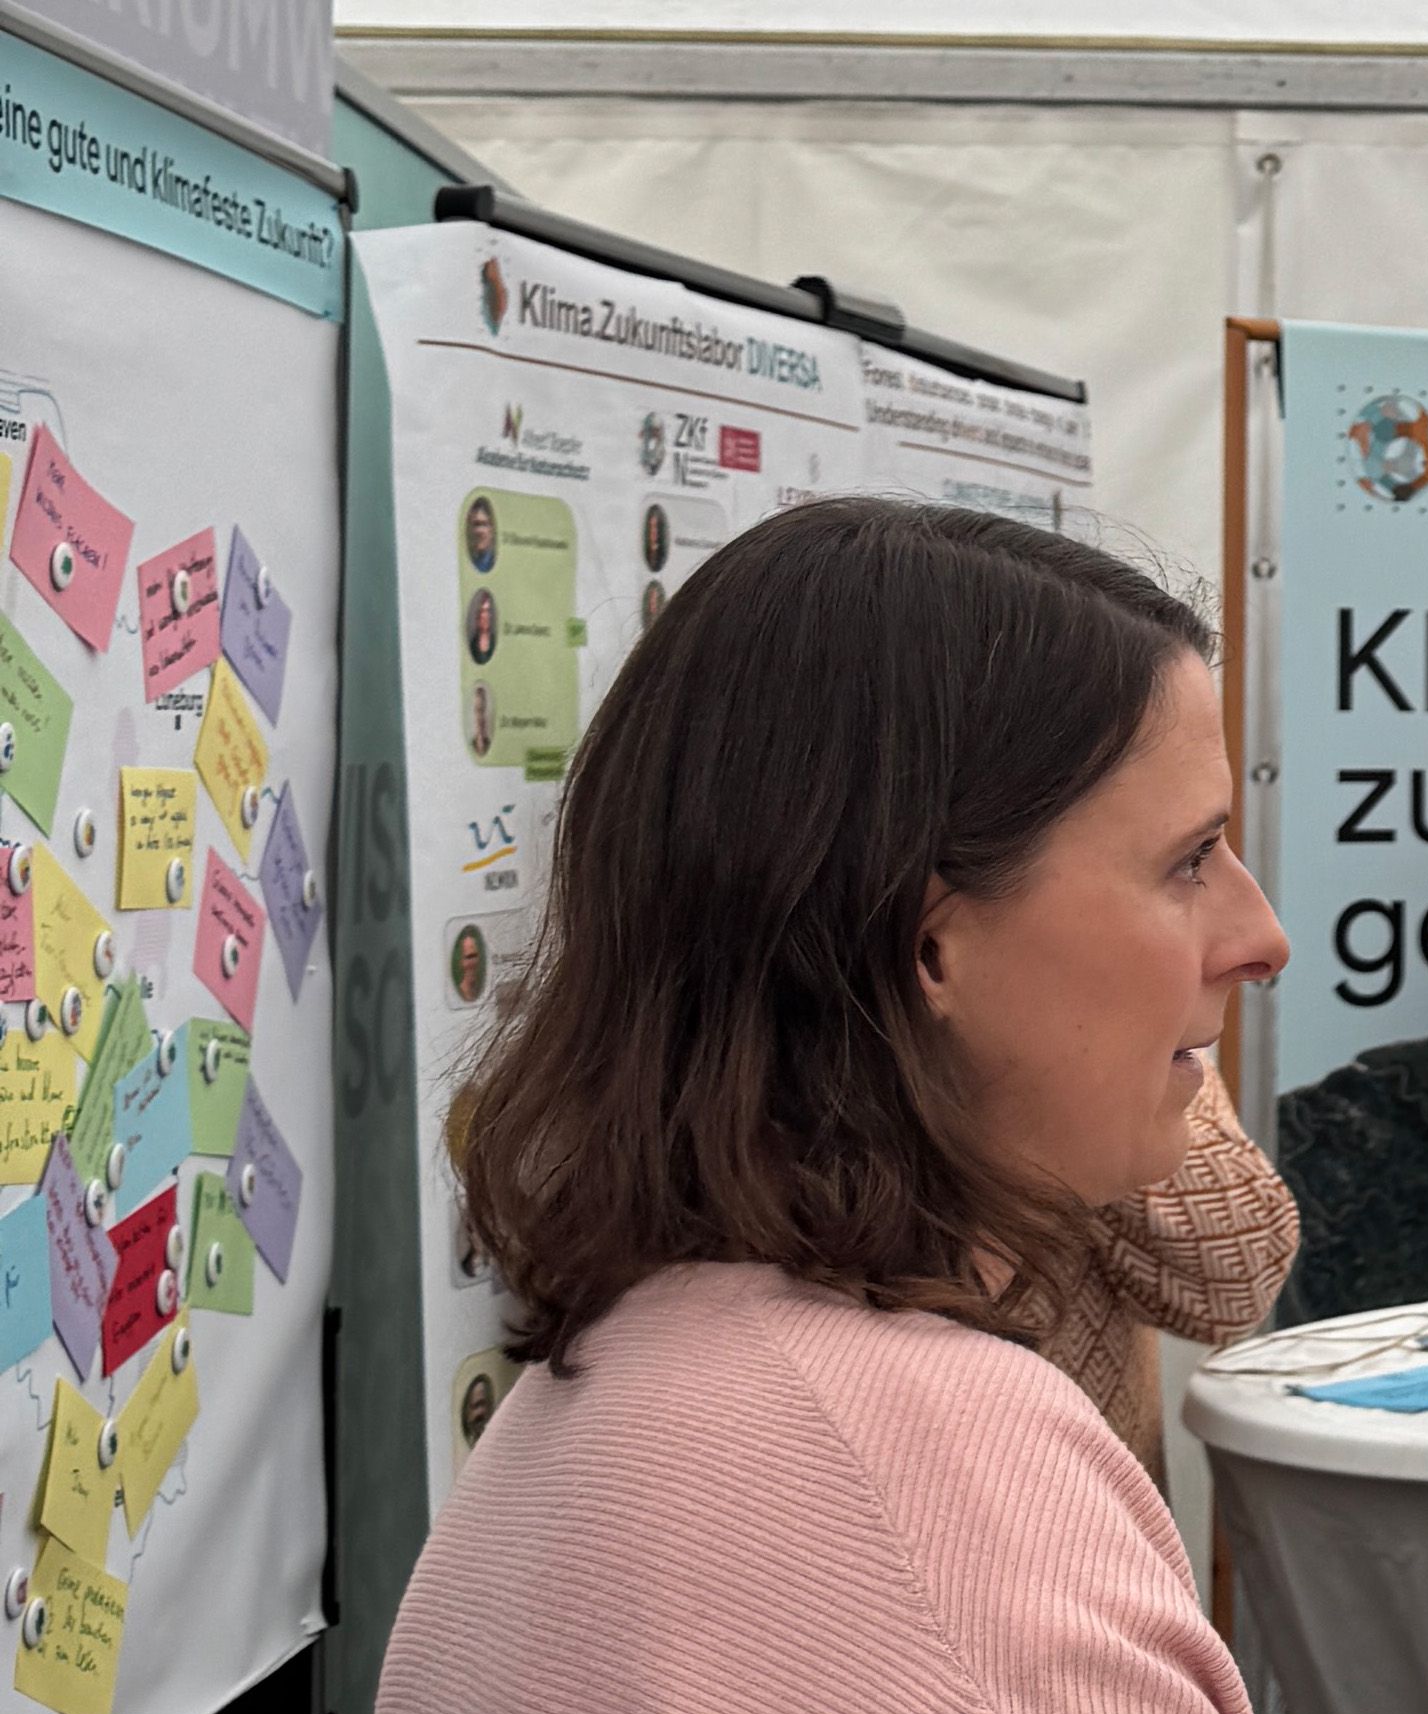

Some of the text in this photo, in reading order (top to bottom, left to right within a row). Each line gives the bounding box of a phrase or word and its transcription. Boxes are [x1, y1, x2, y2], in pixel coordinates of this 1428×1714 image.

[47, 118, 100, 173] gute
[106, 143, 147, 194] und
[151, 151, 252, 239] klimafeste
[254, 198, 335, 269] Zukunft?
[518, 280, 743, 373] Klima.Zukunftslabor
